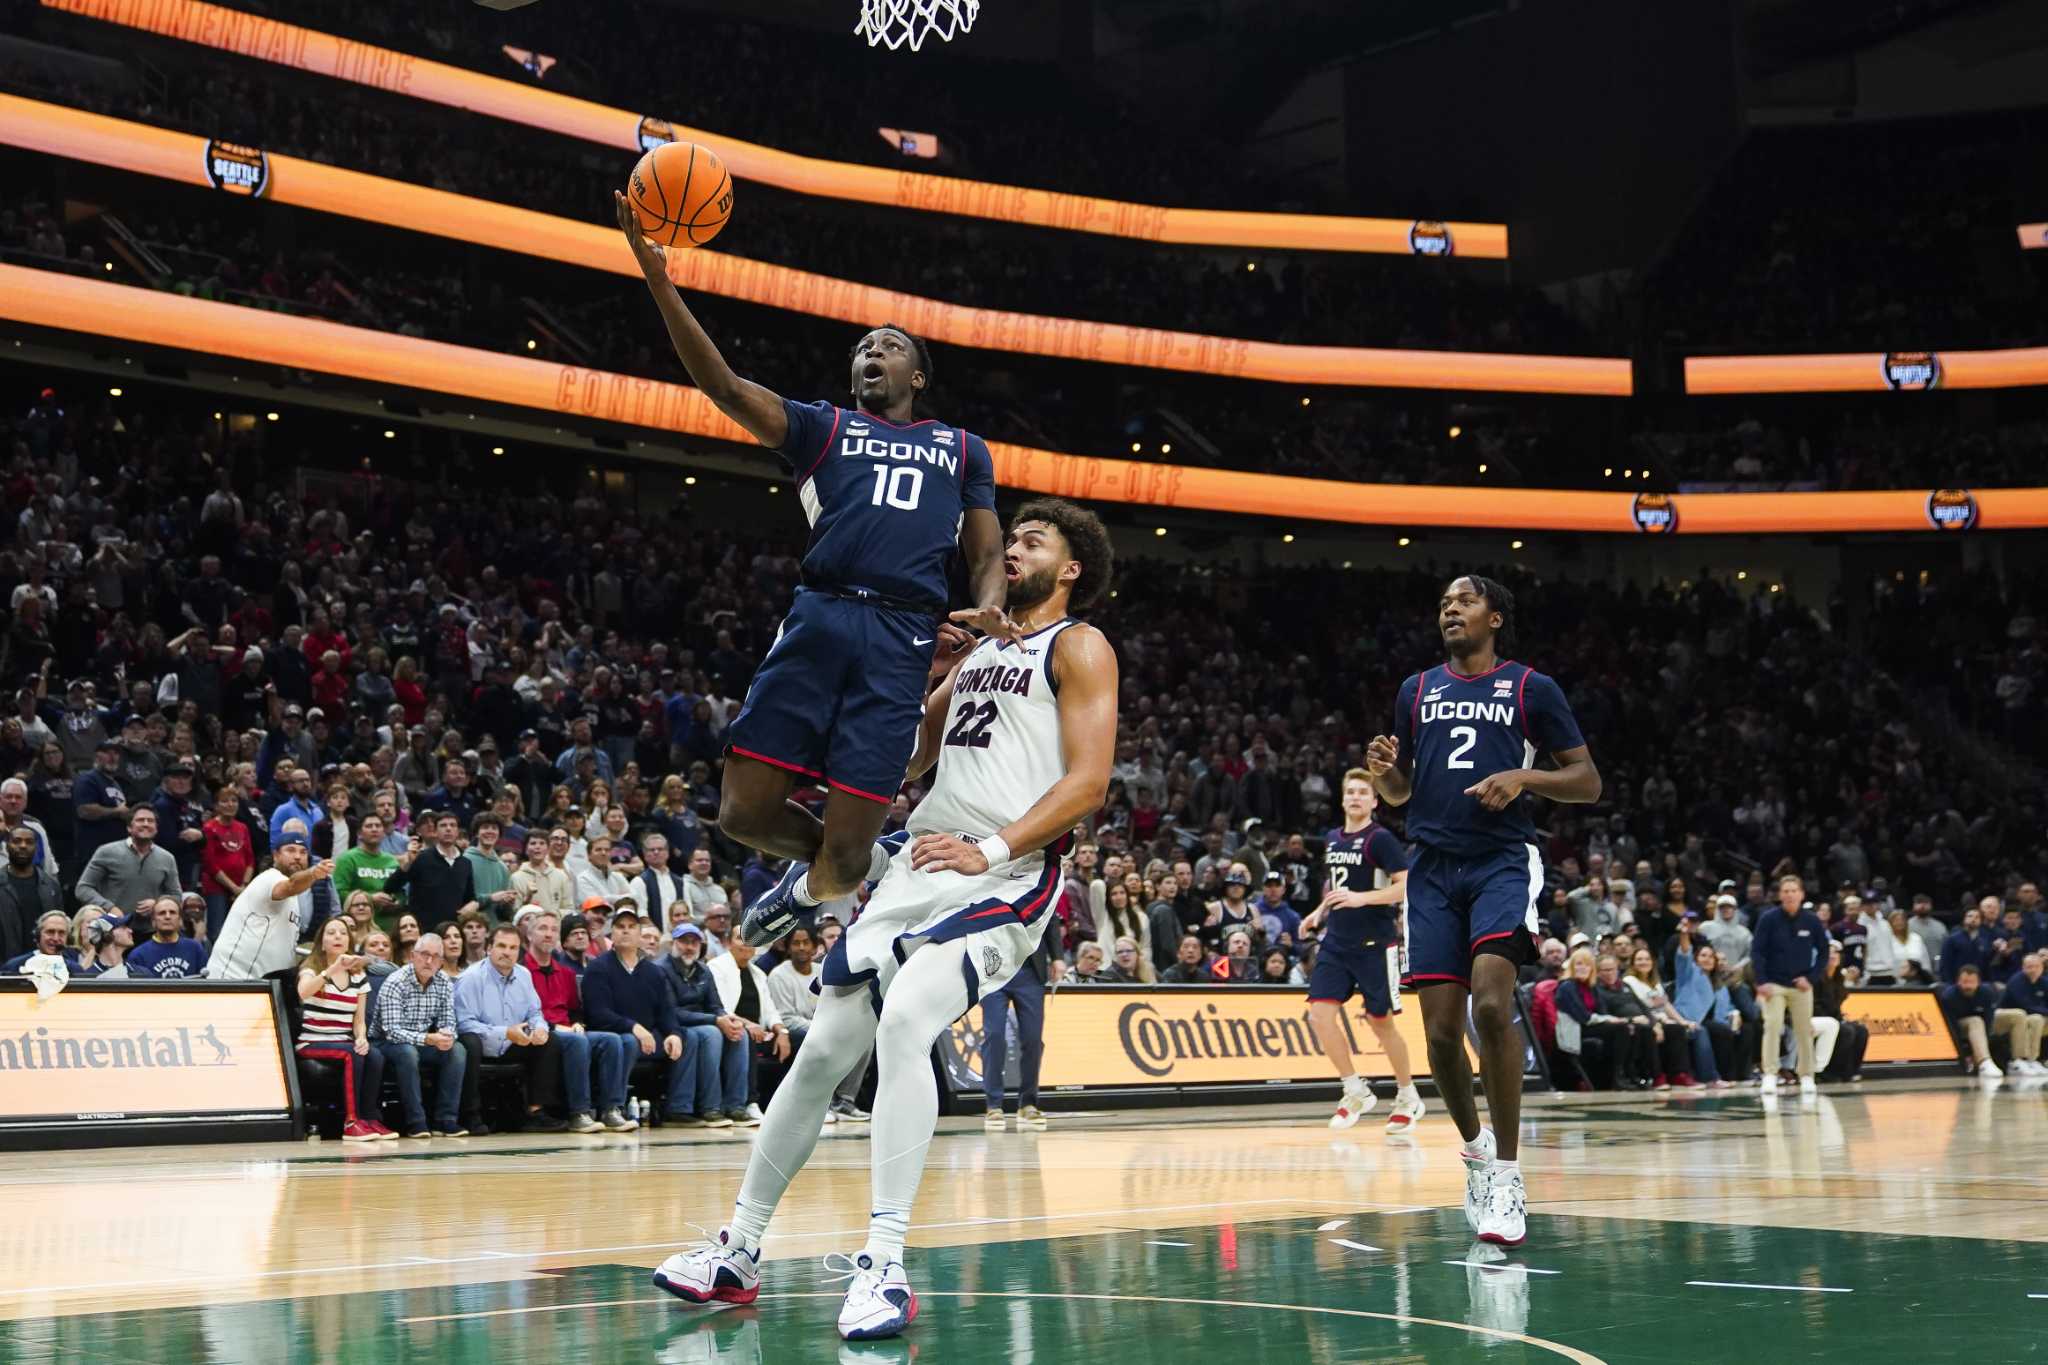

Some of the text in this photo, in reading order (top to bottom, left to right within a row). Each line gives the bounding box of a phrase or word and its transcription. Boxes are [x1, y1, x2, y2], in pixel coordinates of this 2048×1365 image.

[841, 437, 958, 477] UCONN
[871, 463, 924, 511] 10
[1051, 452, 1183, 506] TIP-OFF
[952, 664, 1034, 698] GONZAGA
[944, 700, 998, 749] 22
[1420, 701, 1514, 726] UCONN
[1447, 725, 1477, 770] 2
[1330, 866, 1349, 892] 12
[153, 956, 190, 973] UCONN
[1117, 1001, 1362, 1077] Continentl
